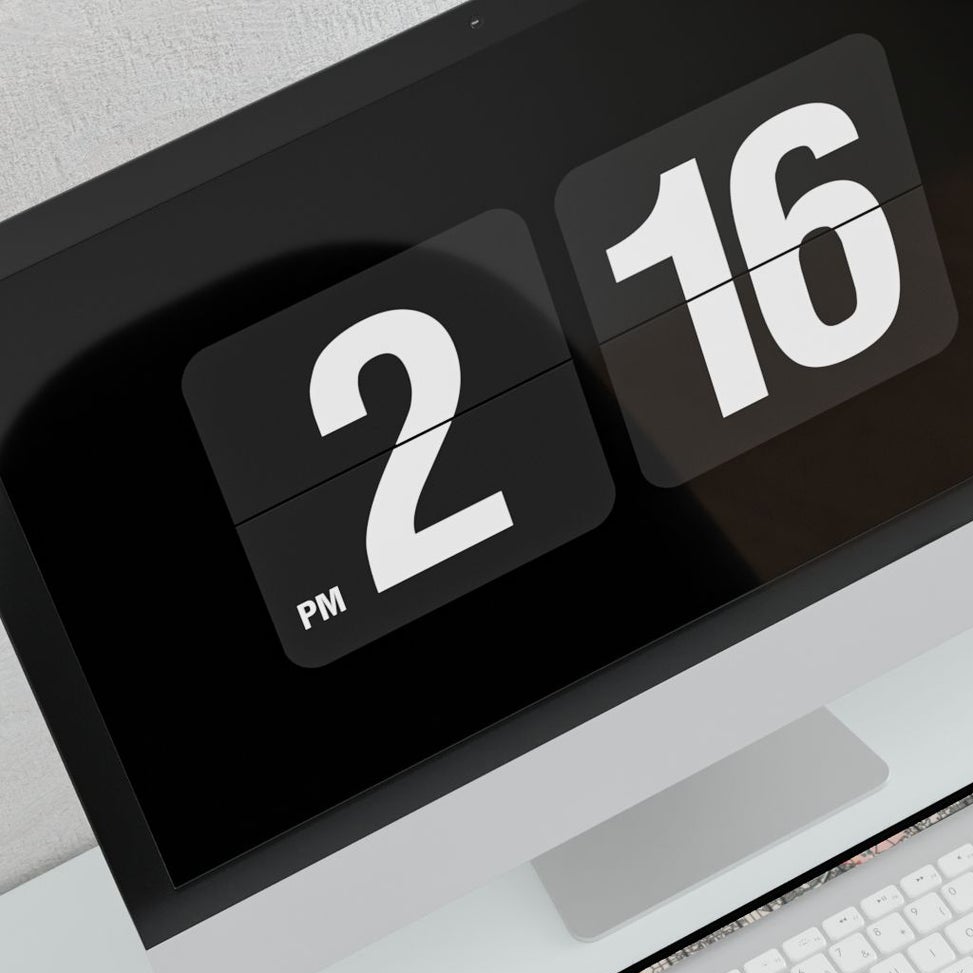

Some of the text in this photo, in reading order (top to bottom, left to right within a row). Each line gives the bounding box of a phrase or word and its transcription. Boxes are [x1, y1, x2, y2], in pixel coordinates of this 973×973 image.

[308, 101, 902, 594] 2 16
[295, 584, 348, 631] PM
